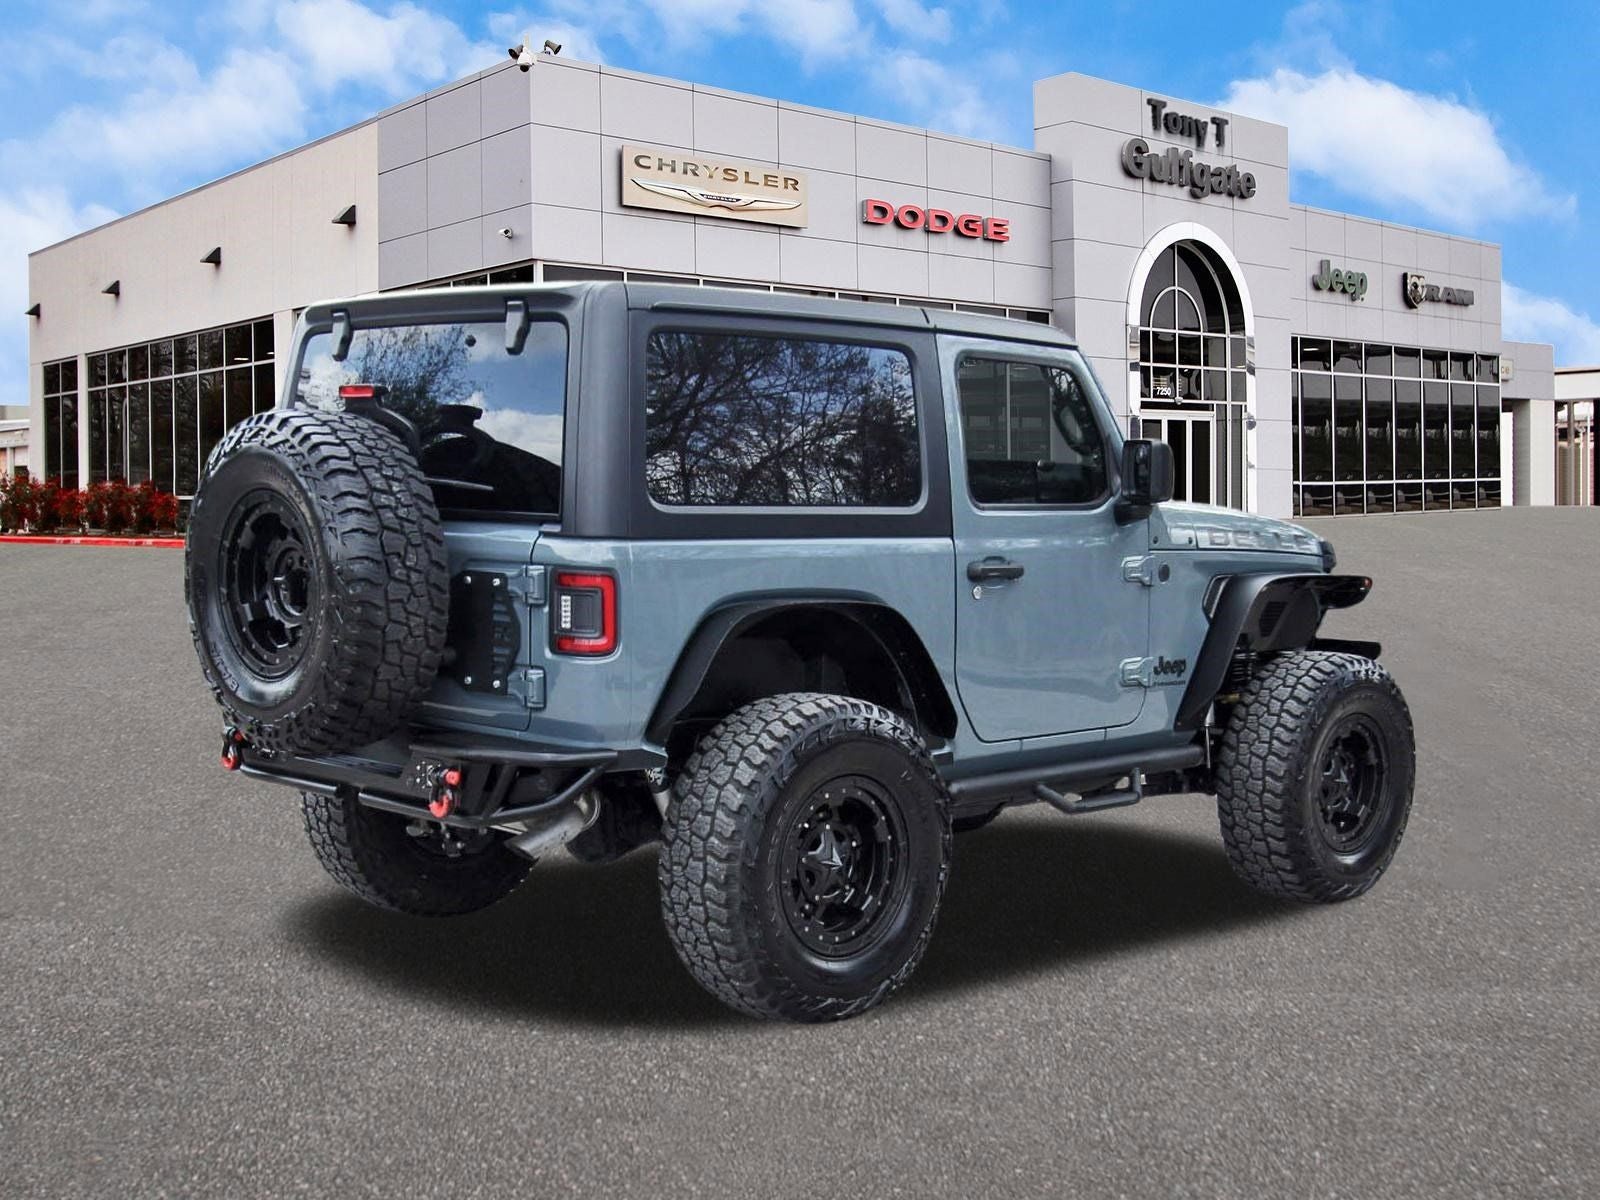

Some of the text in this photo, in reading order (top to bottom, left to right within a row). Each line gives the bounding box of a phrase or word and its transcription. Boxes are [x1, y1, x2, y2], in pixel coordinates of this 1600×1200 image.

[1146, 98, 1229, 147] Tony T
[633, 153, 801, 192] CHRYSLER
[1121, 138, 1257, 199] Gulfgate
[862, 198, 1010, 242] DODGE
[1312, 259, 1368, 302] Jeep
[1424, 284, 1475, 307] RAM
[1156, 386, 1172, 396] 7250
[1153, 655, 1187, 678] Jeep
